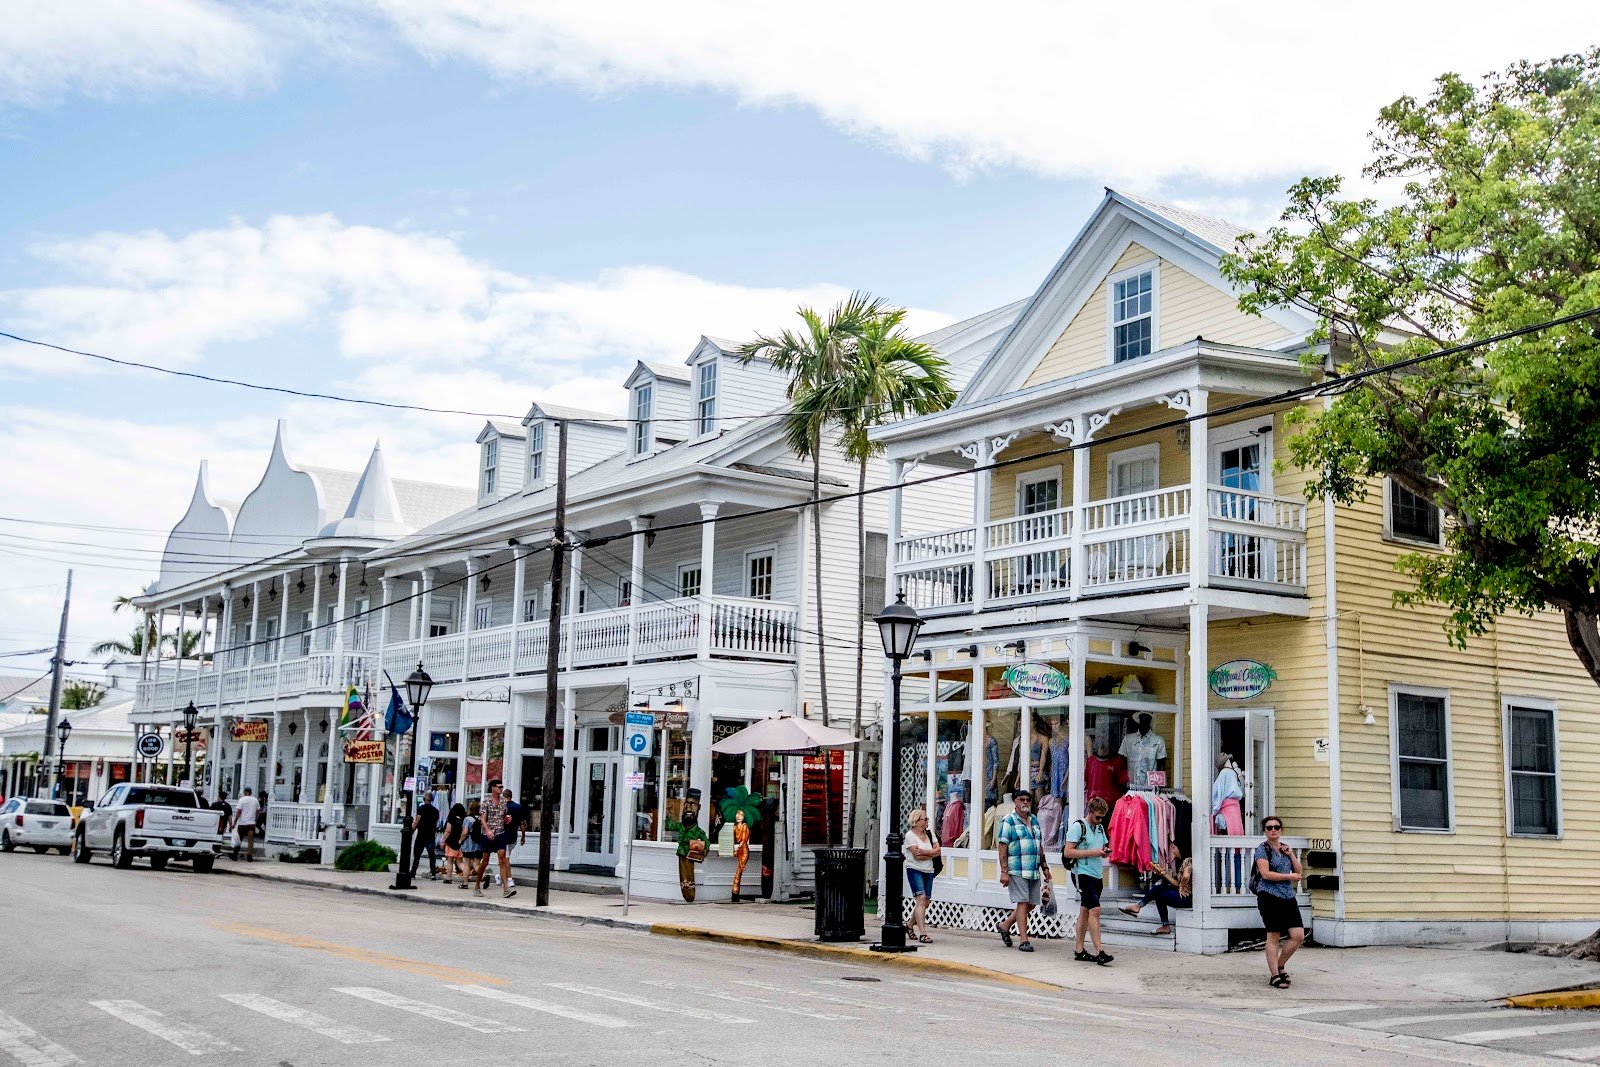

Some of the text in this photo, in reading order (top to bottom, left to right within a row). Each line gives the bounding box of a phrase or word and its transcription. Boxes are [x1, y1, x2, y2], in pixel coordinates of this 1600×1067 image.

[713, 722, 741, 736] igars
[358, 743, 381, 752] HAPPY
[634, 736, 643, 748] P
[352, 750, 384, 760] ROOSTER
[1312, 838, 1331, 850] 1100
